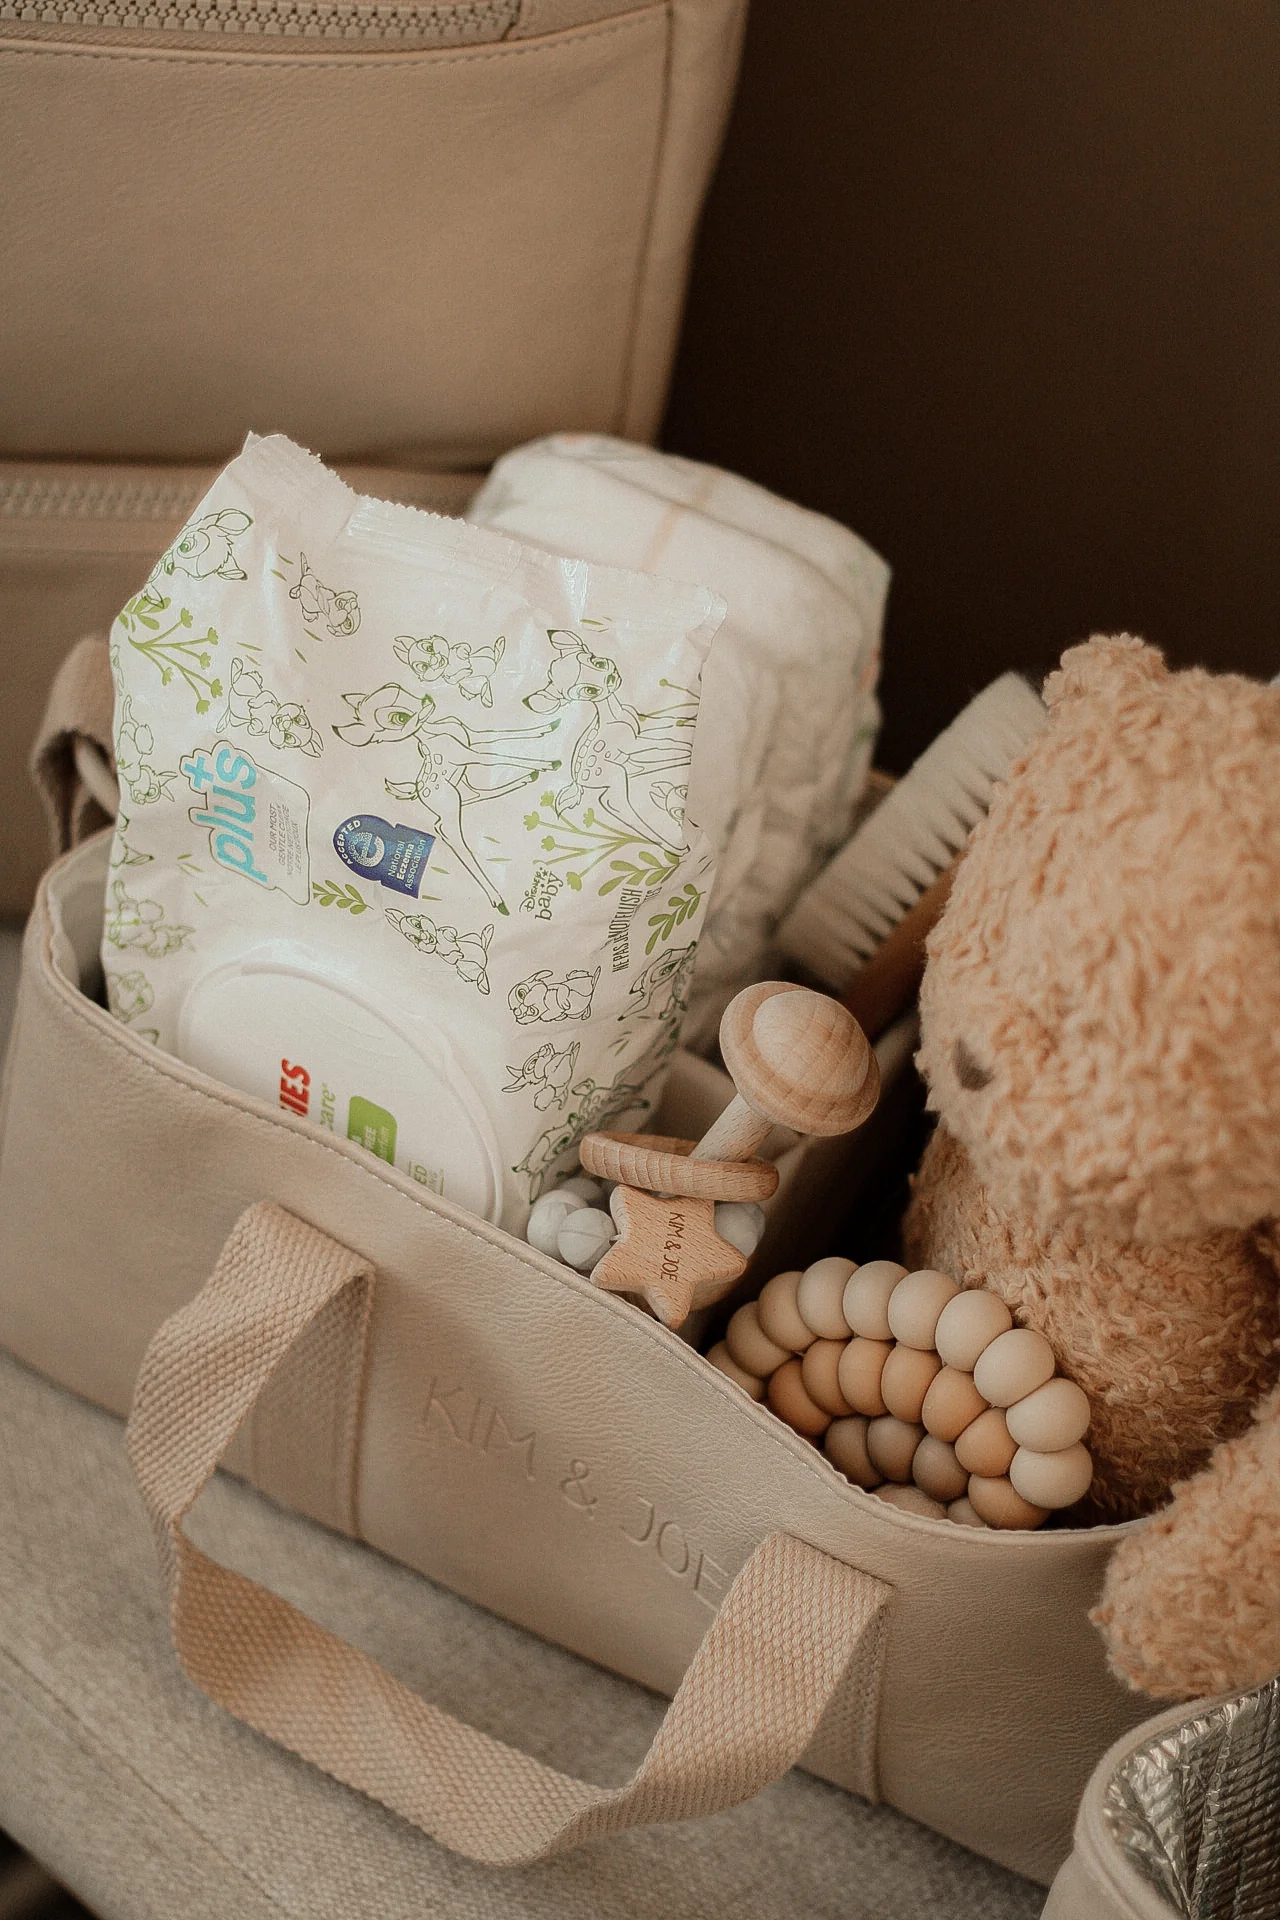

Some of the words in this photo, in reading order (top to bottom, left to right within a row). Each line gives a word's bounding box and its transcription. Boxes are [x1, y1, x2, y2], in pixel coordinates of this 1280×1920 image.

[269, 803, 277, 831] MOST
[269, 831, 277, 851] OUR
[337, 819, 361, 865] ACCEPTED
[388, 840, 406, 877] National
[396, 843, 415, 880] Eczema
[404, 839, 426, 890] Association
[534, 871, 564, 920] baby
[667, 1211, 685, 1239] KIM
[663, 1240, 681, 1250] &
[660, 1253, 680, 1282] JOE
[420, 1377, 537, 1482] KIM
[560, 1459, 599, 1520] &
[620, 1494, 729, 1612] JOE
